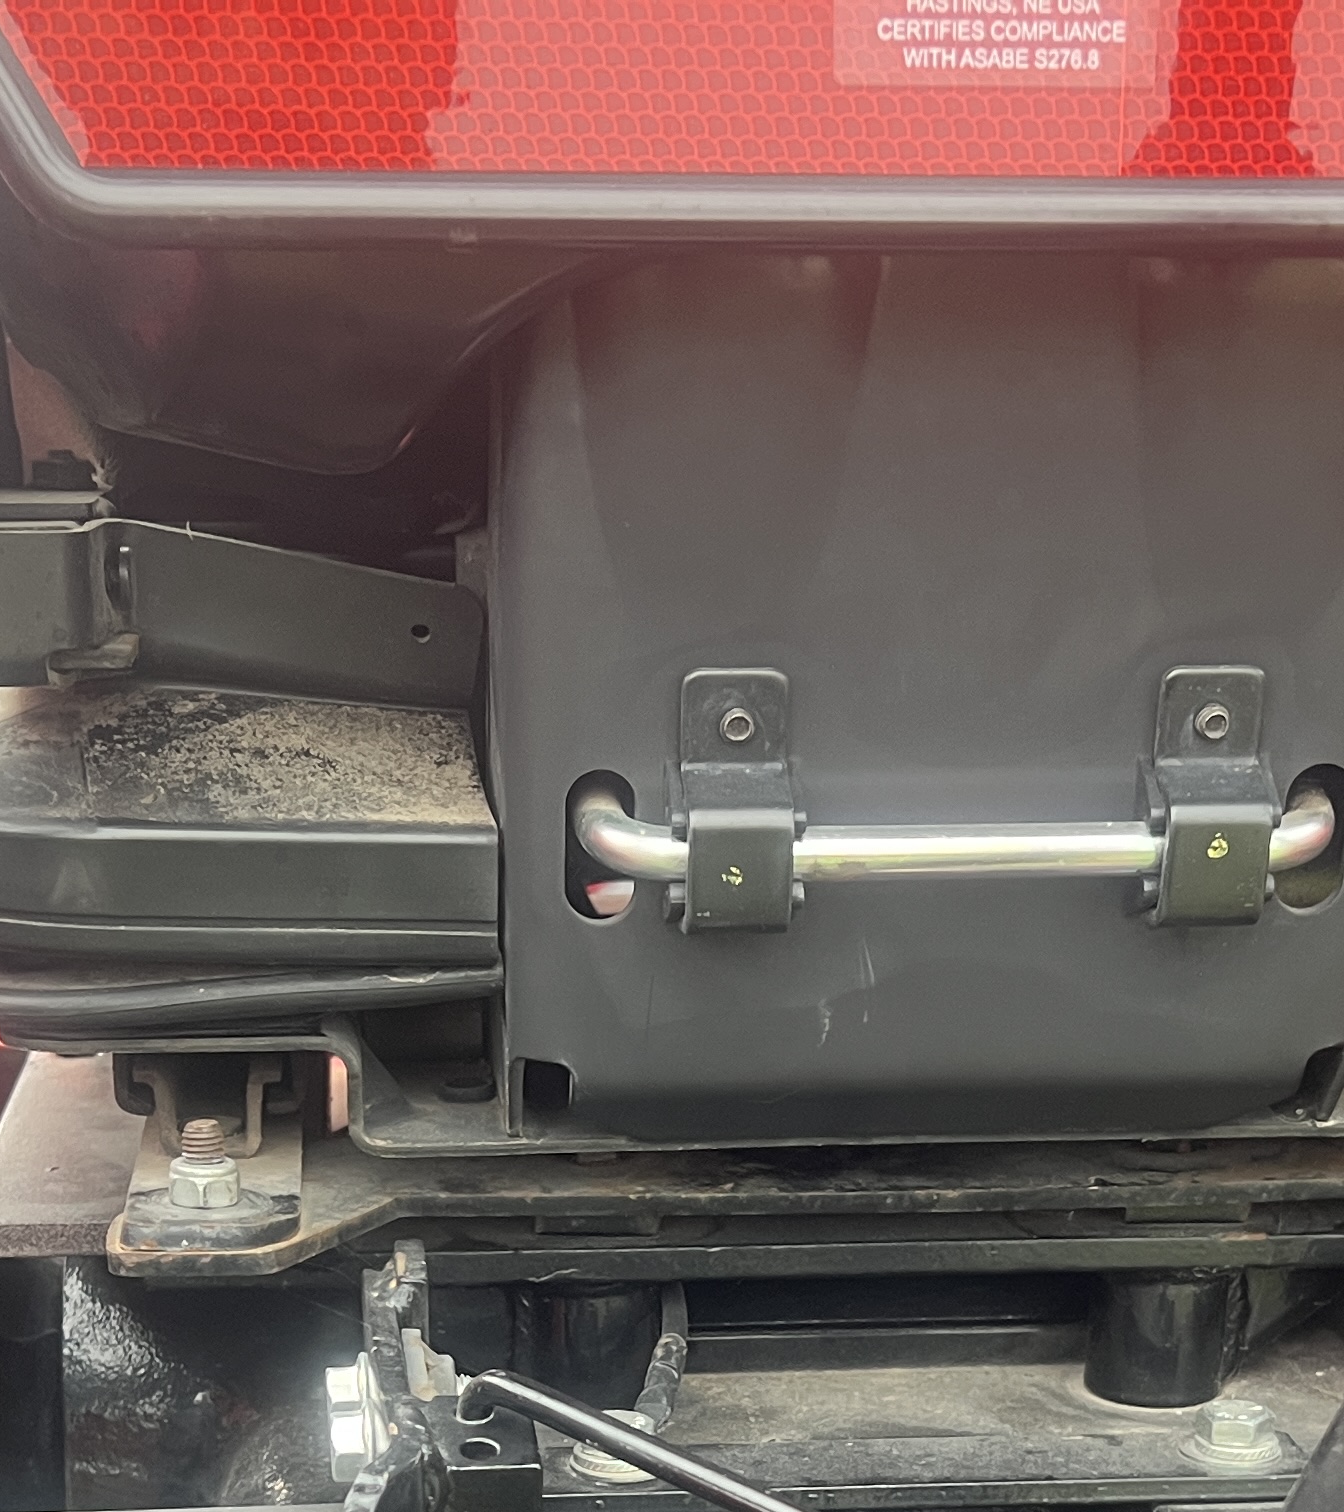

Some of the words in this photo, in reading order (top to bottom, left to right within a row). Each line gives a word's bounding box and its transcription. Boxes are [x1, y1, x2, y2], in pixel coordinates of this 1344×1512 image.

[877, 18, 985, 41] CERTIFIES
[990, 19, 1127, 43] COMPLIANCE
[903, 47, 956, 69] WITH
[959, 48, 1029, 70] ASABE
